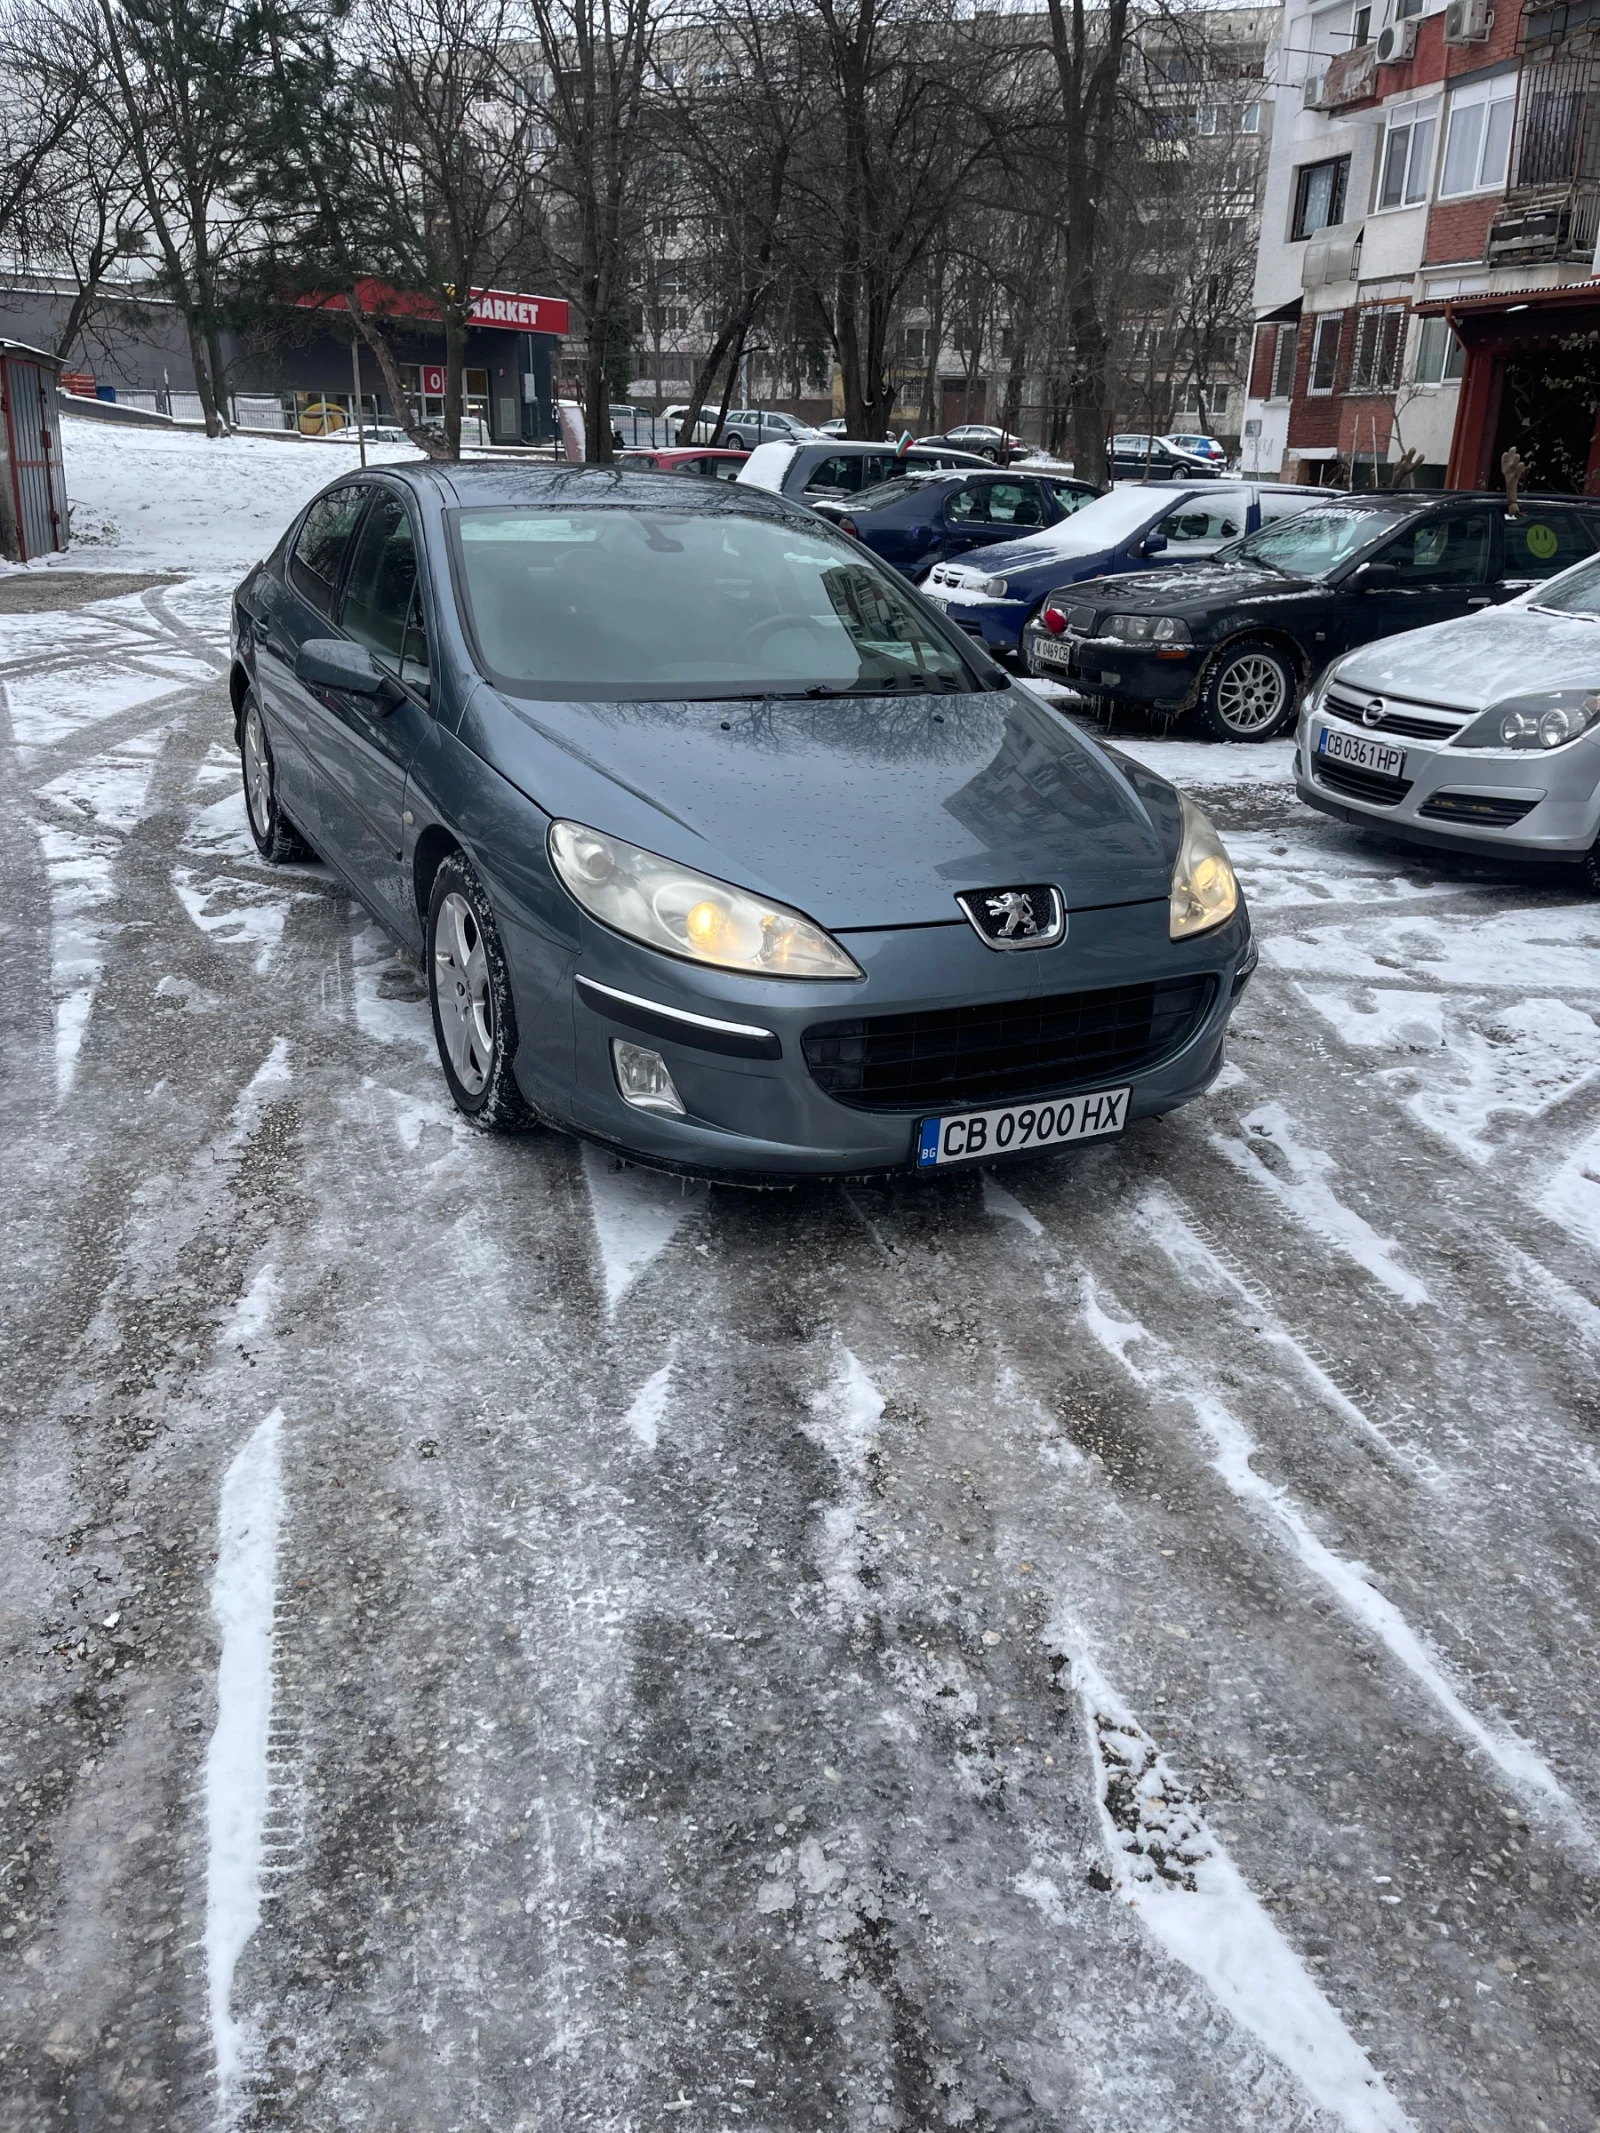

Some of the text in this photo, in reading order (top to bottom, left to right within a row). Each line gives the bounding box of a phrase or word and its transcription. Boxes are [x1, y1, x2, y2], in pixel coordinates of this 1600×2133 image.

[1327, 734, 1399, 771] CB 0361 HP
[943, 1093, 1124, 1156] CB 0900 HX
[921, 1148, 936, 1160] BG
